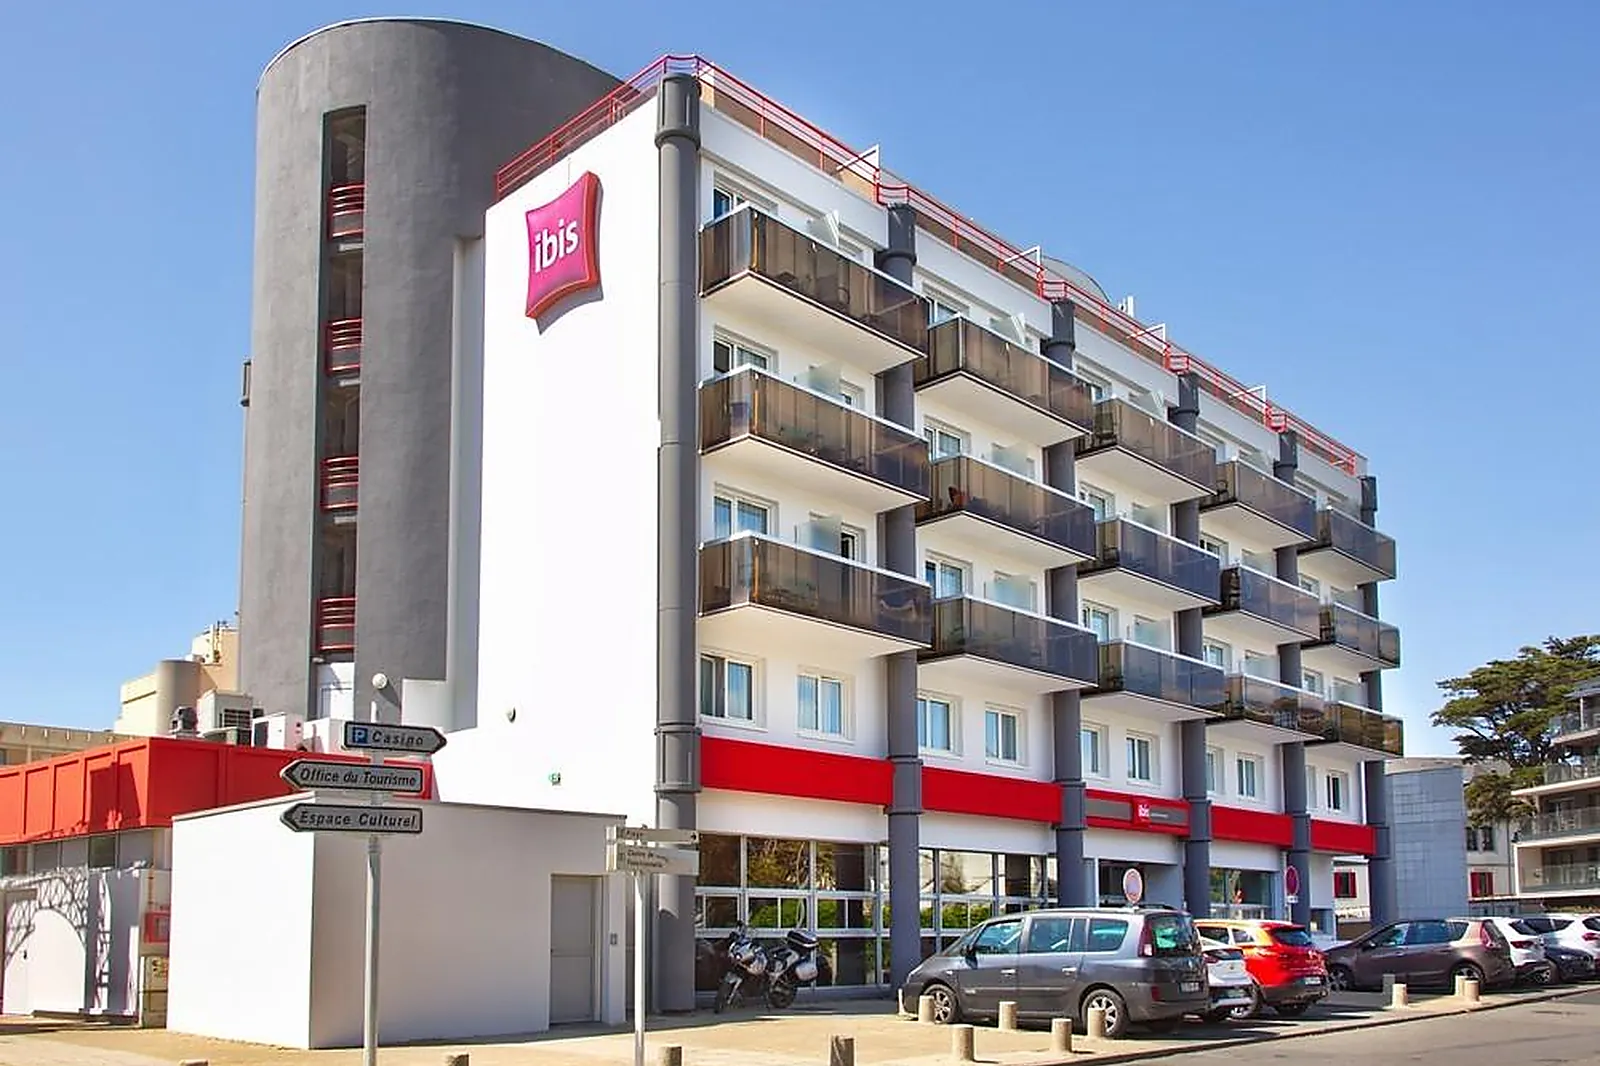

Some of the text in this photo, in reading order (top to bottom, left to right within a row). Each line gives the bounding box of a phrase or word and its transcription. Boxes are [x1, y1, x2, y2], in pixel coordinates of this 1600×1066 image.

[535, 218, 579, 273] ibis
[355, 729, 424, 746] P Casino
[300, 767, 416, 786] Office du Tourisme
[300, 811, 416, 829] Espace Culturel
